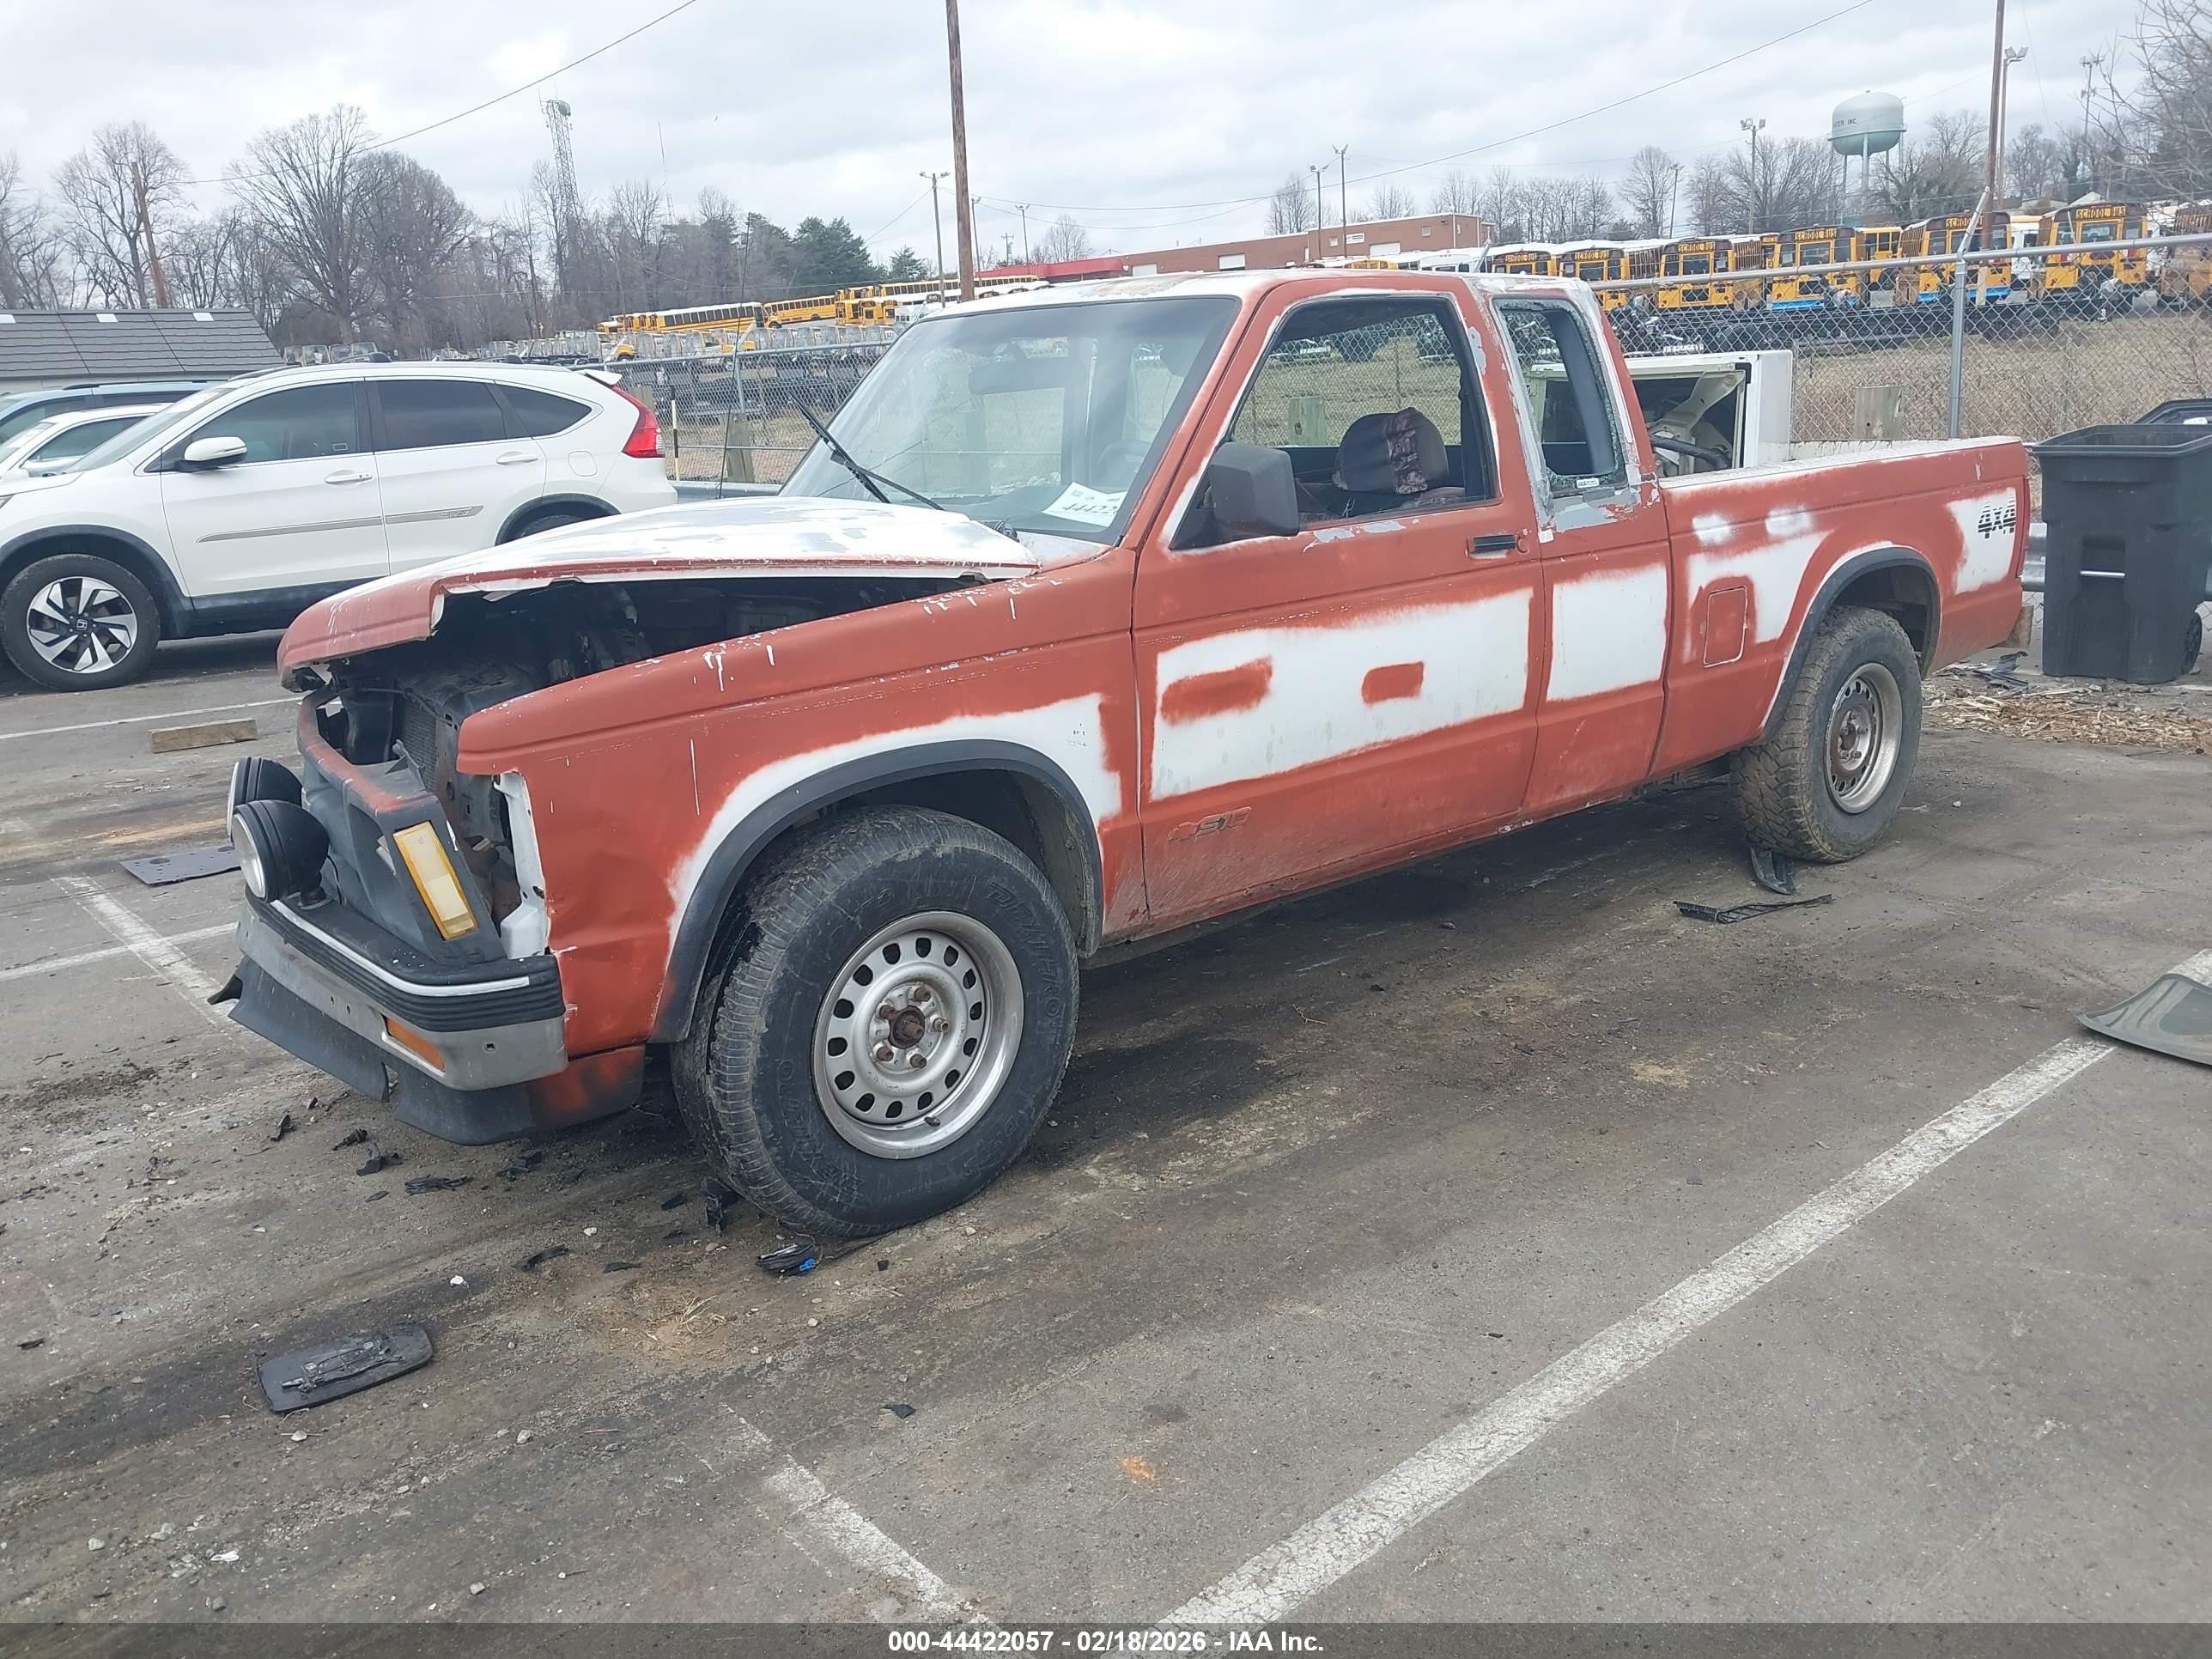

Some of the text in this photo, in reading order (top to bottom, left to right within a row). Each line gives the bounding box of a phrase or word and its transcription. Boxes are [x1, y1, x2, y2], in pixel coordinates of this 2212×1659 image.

[2076, 209, 2105, 219] SCHOOL
[1796, 232, 1820, 241] SCHOOL
[1679, 242, 1715, 252] SCHOOL BUS
